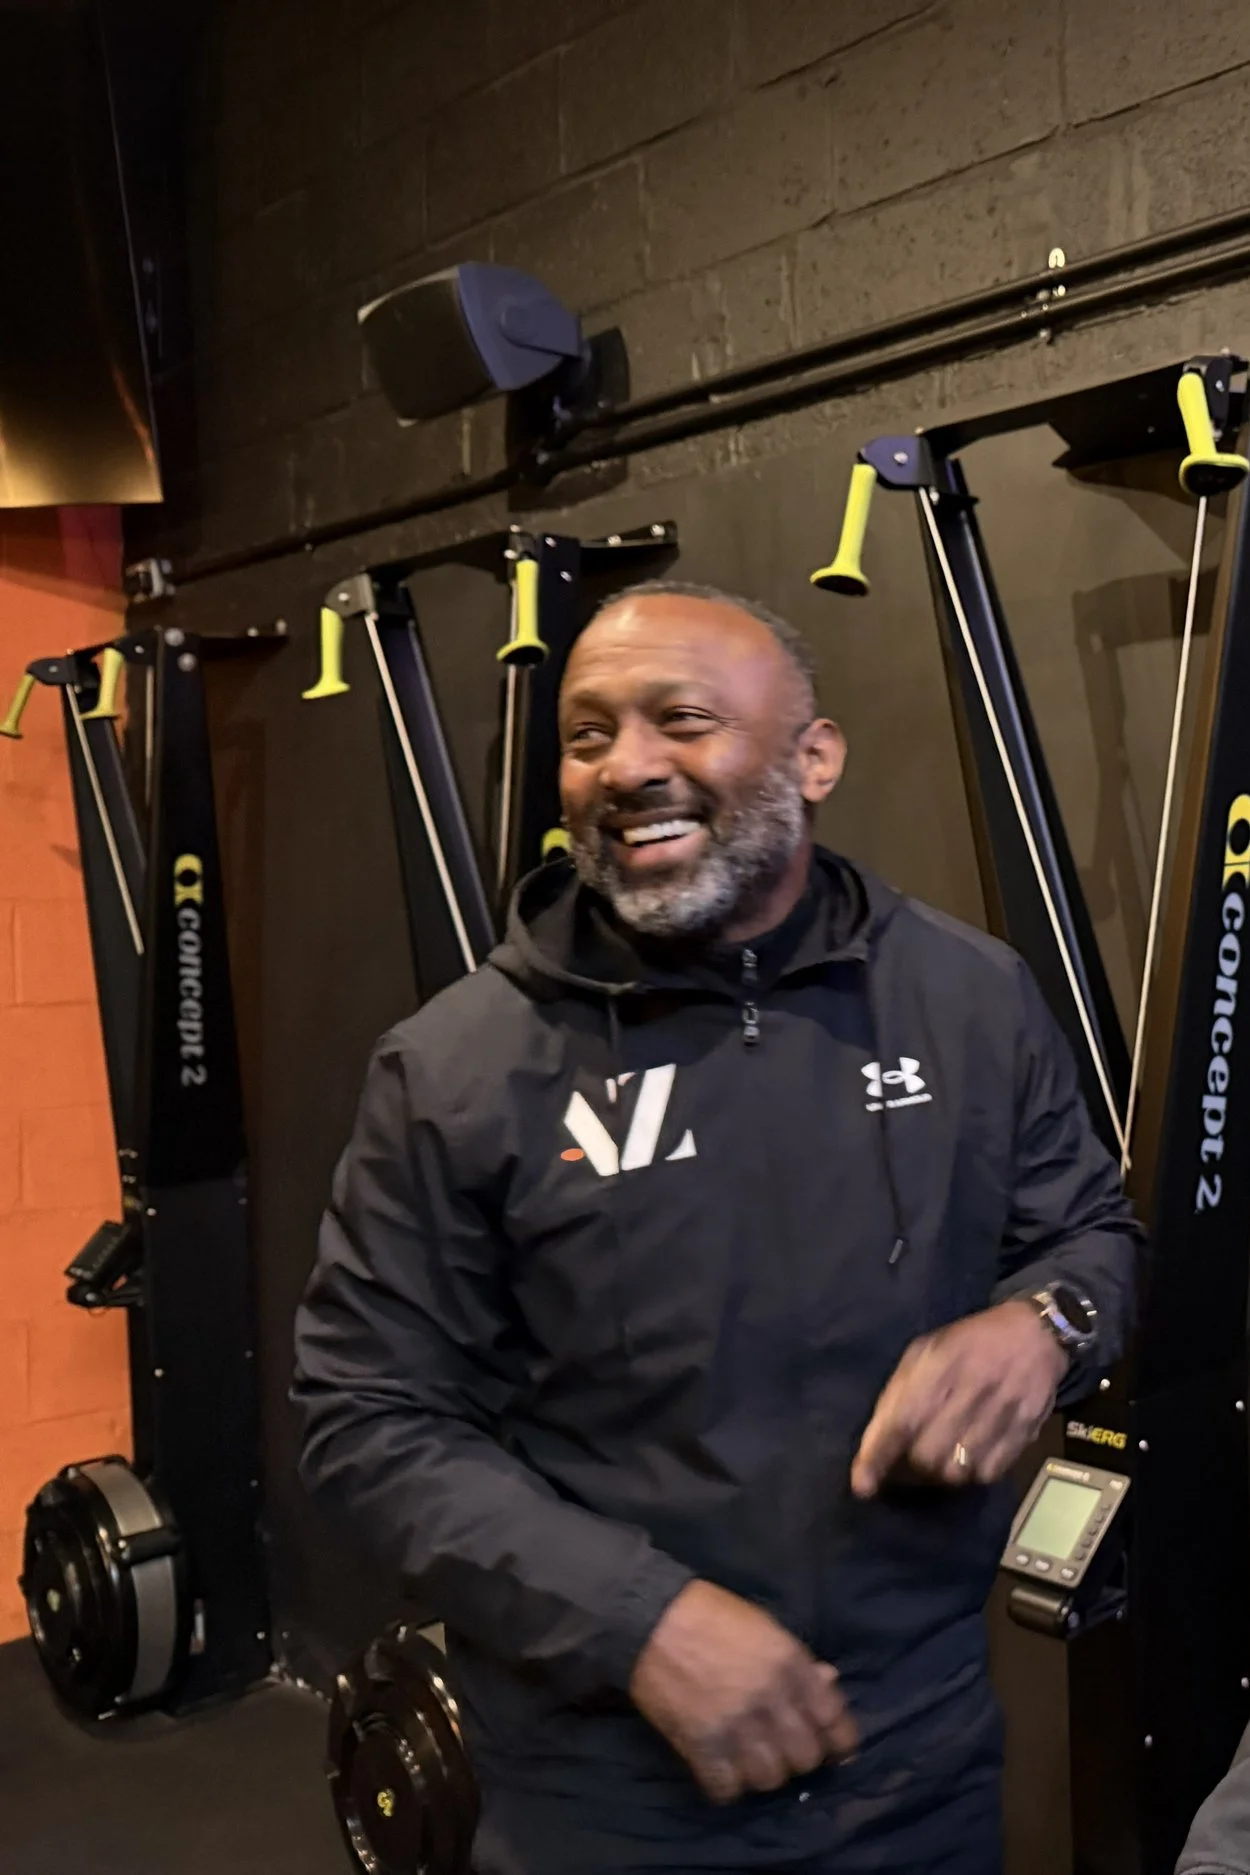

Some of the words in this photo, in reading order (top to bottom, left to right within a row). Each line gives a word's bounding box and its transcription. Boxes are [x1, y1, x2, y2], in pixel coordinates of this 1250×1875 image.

[177, 907, 205, 1060] concept
[1201, 892, 1246, 1162] concept
[181, 1064, 208, 1087] 2
[1195, 1174, 1222, 1209] 2
[1066, 1420, 1128, 1450] SkiERG
